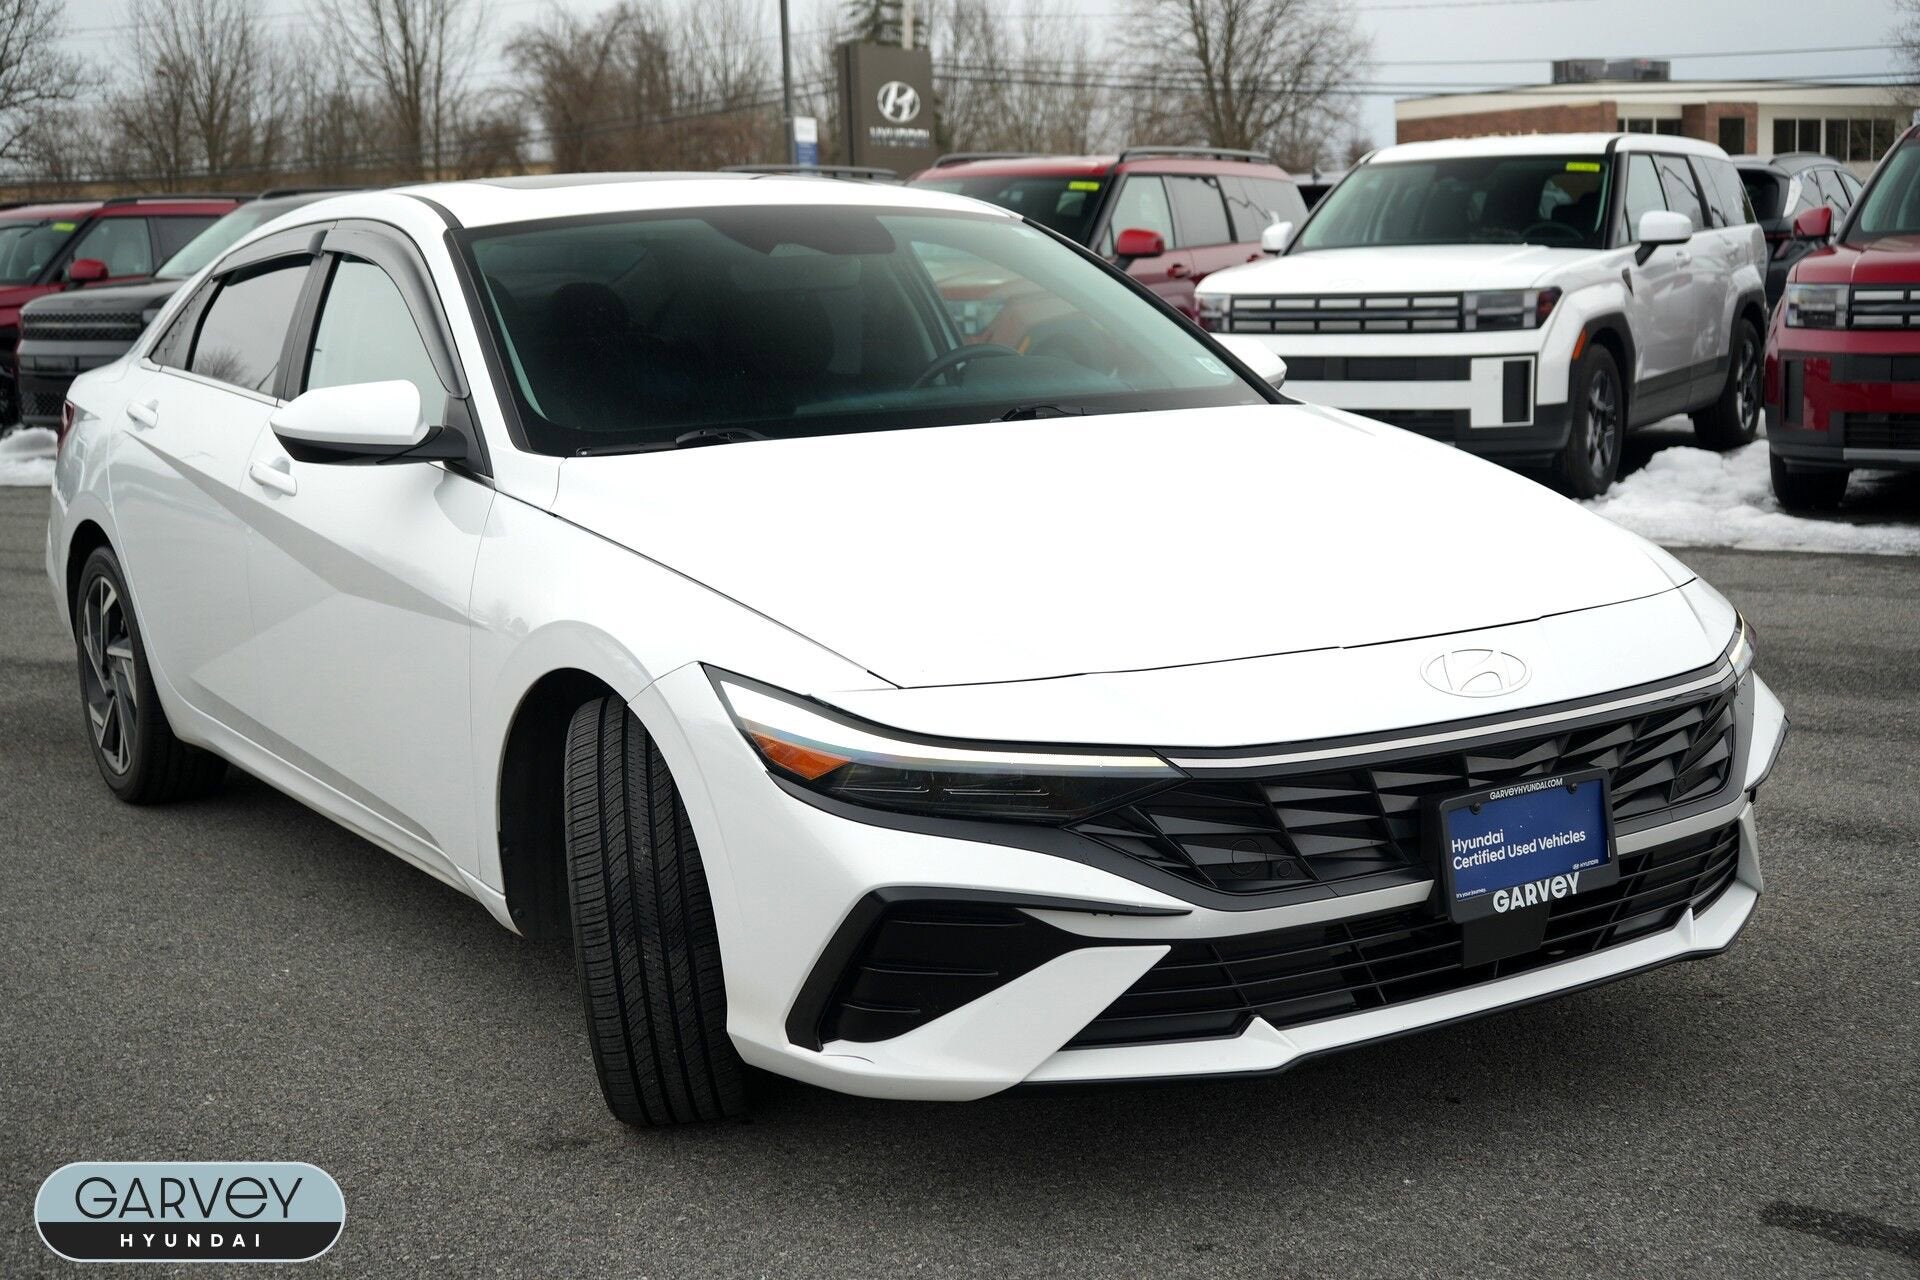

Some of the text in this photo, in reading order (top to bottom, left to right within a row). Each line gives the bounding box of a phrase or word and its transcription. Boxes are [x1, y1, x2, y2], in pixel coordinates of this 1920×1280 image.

[1452, 829, 1504, 854] Hyundai
[1453, 830, 1586, 870] Certified Used Vehicles
